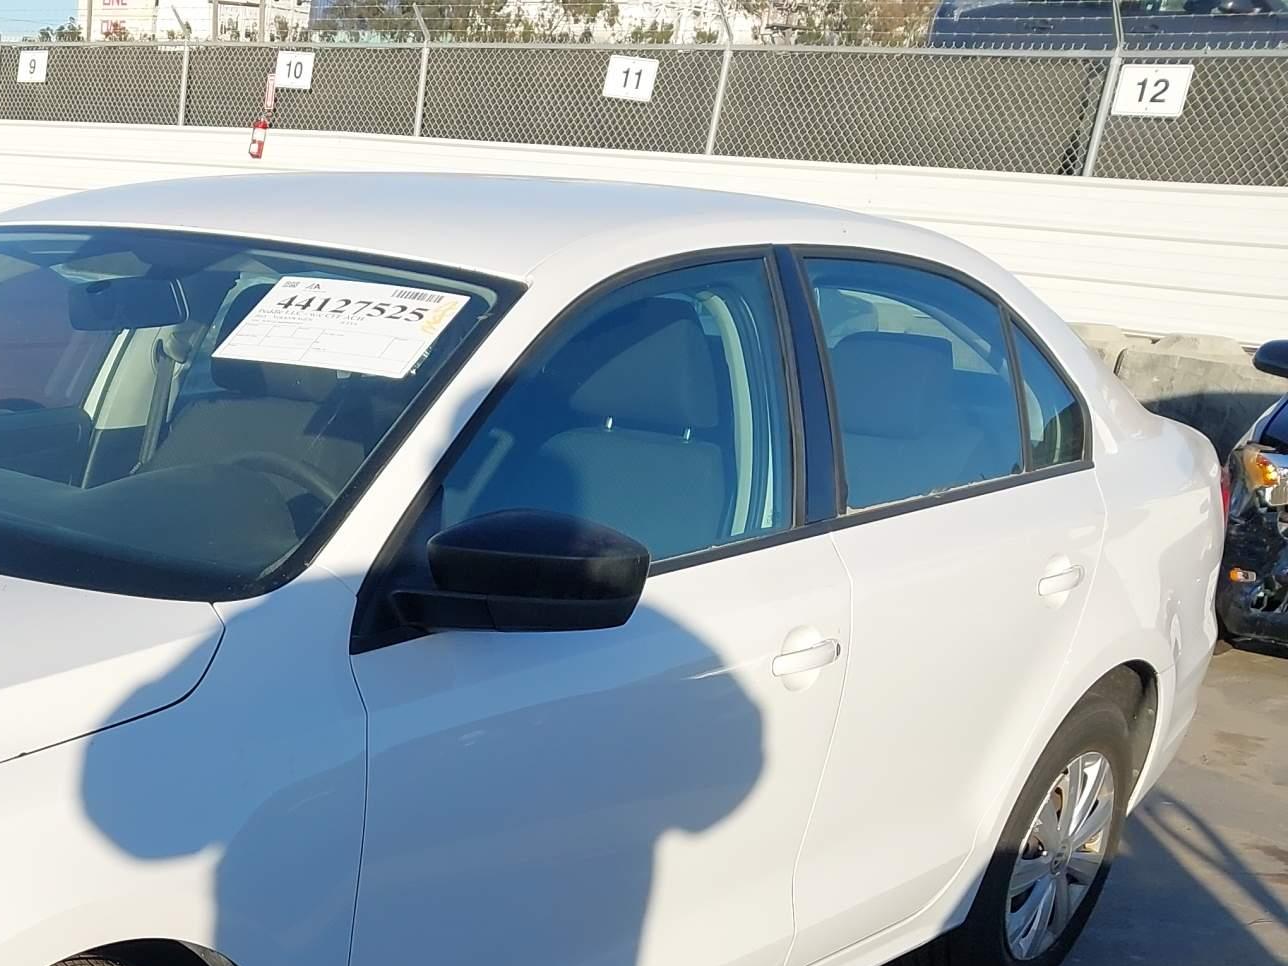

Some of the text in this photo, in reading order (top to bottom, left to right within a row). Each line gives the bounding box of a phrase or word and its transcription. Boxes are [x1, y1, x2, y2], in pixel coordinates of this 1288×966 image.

[29, 59, 36, 74] 9
[286, 60, 303, 79] 10
[622, 67, 642, 89] 11
[1136, 77, 1170, 103] 12
[277, 295, 429, 322] 44127525
